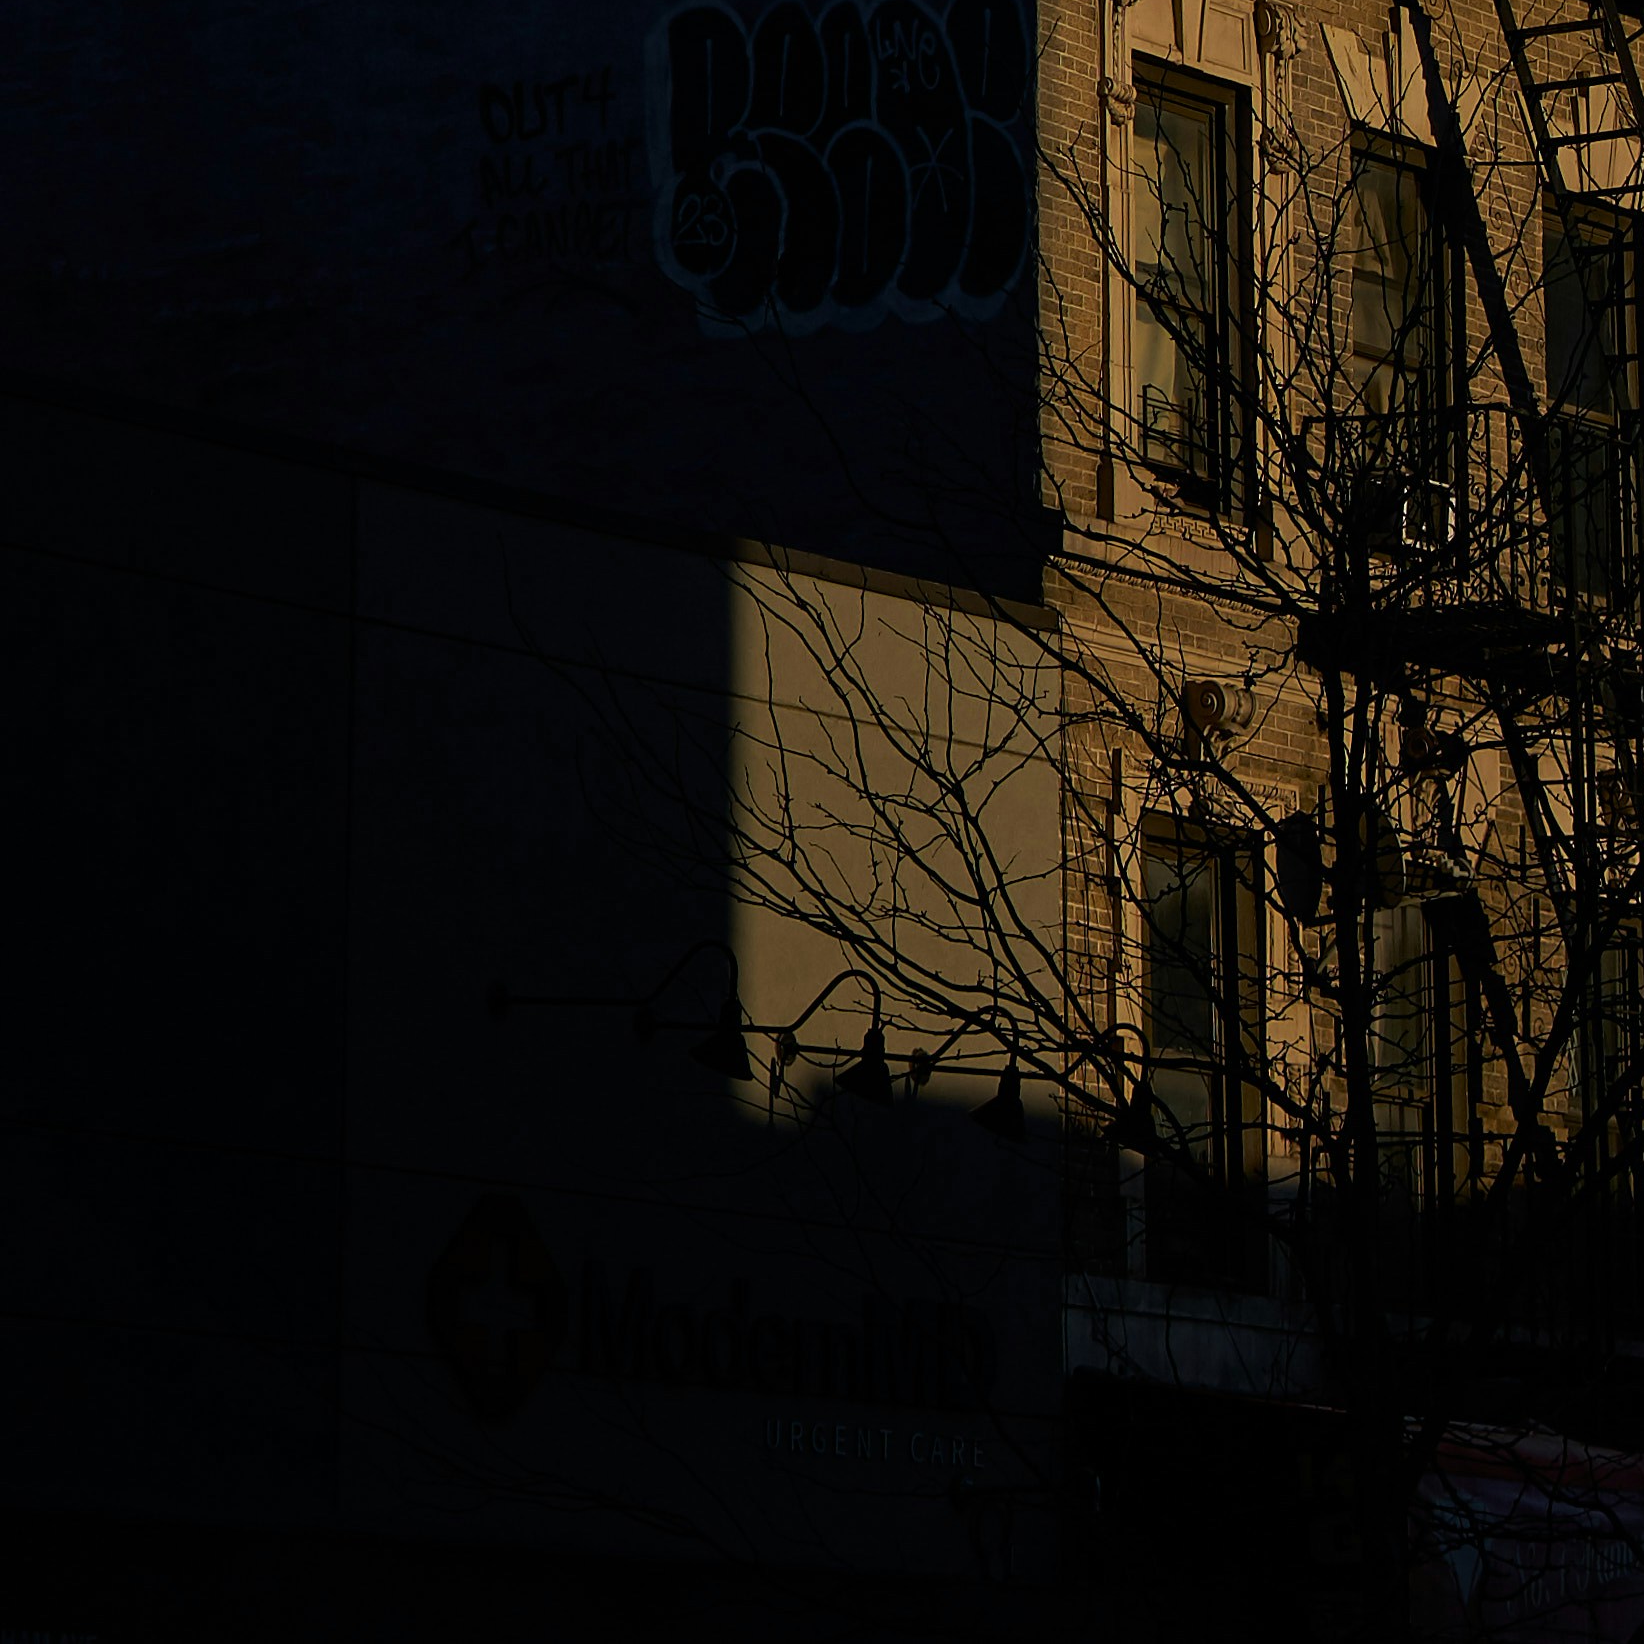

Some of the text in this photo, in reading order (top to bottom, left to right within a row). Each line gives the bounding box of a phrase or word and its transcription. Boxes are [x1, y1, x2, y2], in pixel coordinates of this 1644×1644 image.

[479, 65, 617, 144] OUT 4
[480, 153, 548, 209] ALL
[765, 1417, 988, 1469] URGENT CARE
